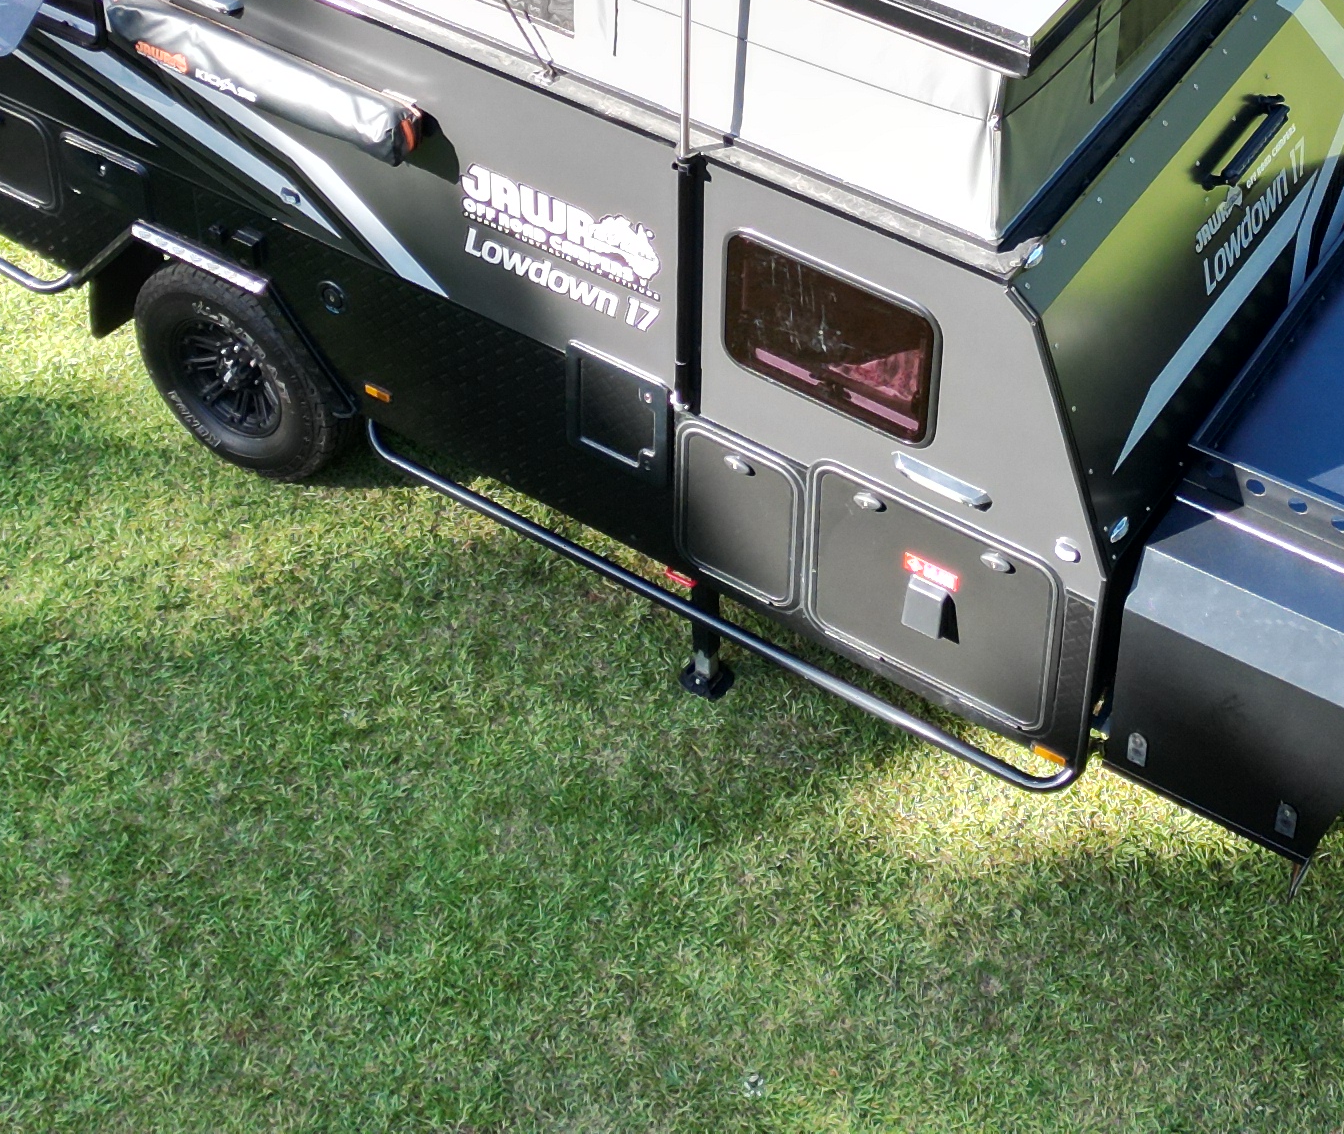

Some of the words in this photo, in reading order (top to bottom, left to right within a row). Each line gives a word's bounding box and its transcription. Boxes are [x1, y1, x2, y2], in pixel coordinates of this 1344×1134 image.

[462, 197, 496, 220] OFF
[498, 213, 547, 243] ROAD
[549, 232, 634, 282] CAMPERS
[1203, 167, 1289, 296] Lowdown
[1290, 135, 1306, 185] 17
[464, 226, 619, 318] Lowdown
[625, 297, 660, 332] 17
